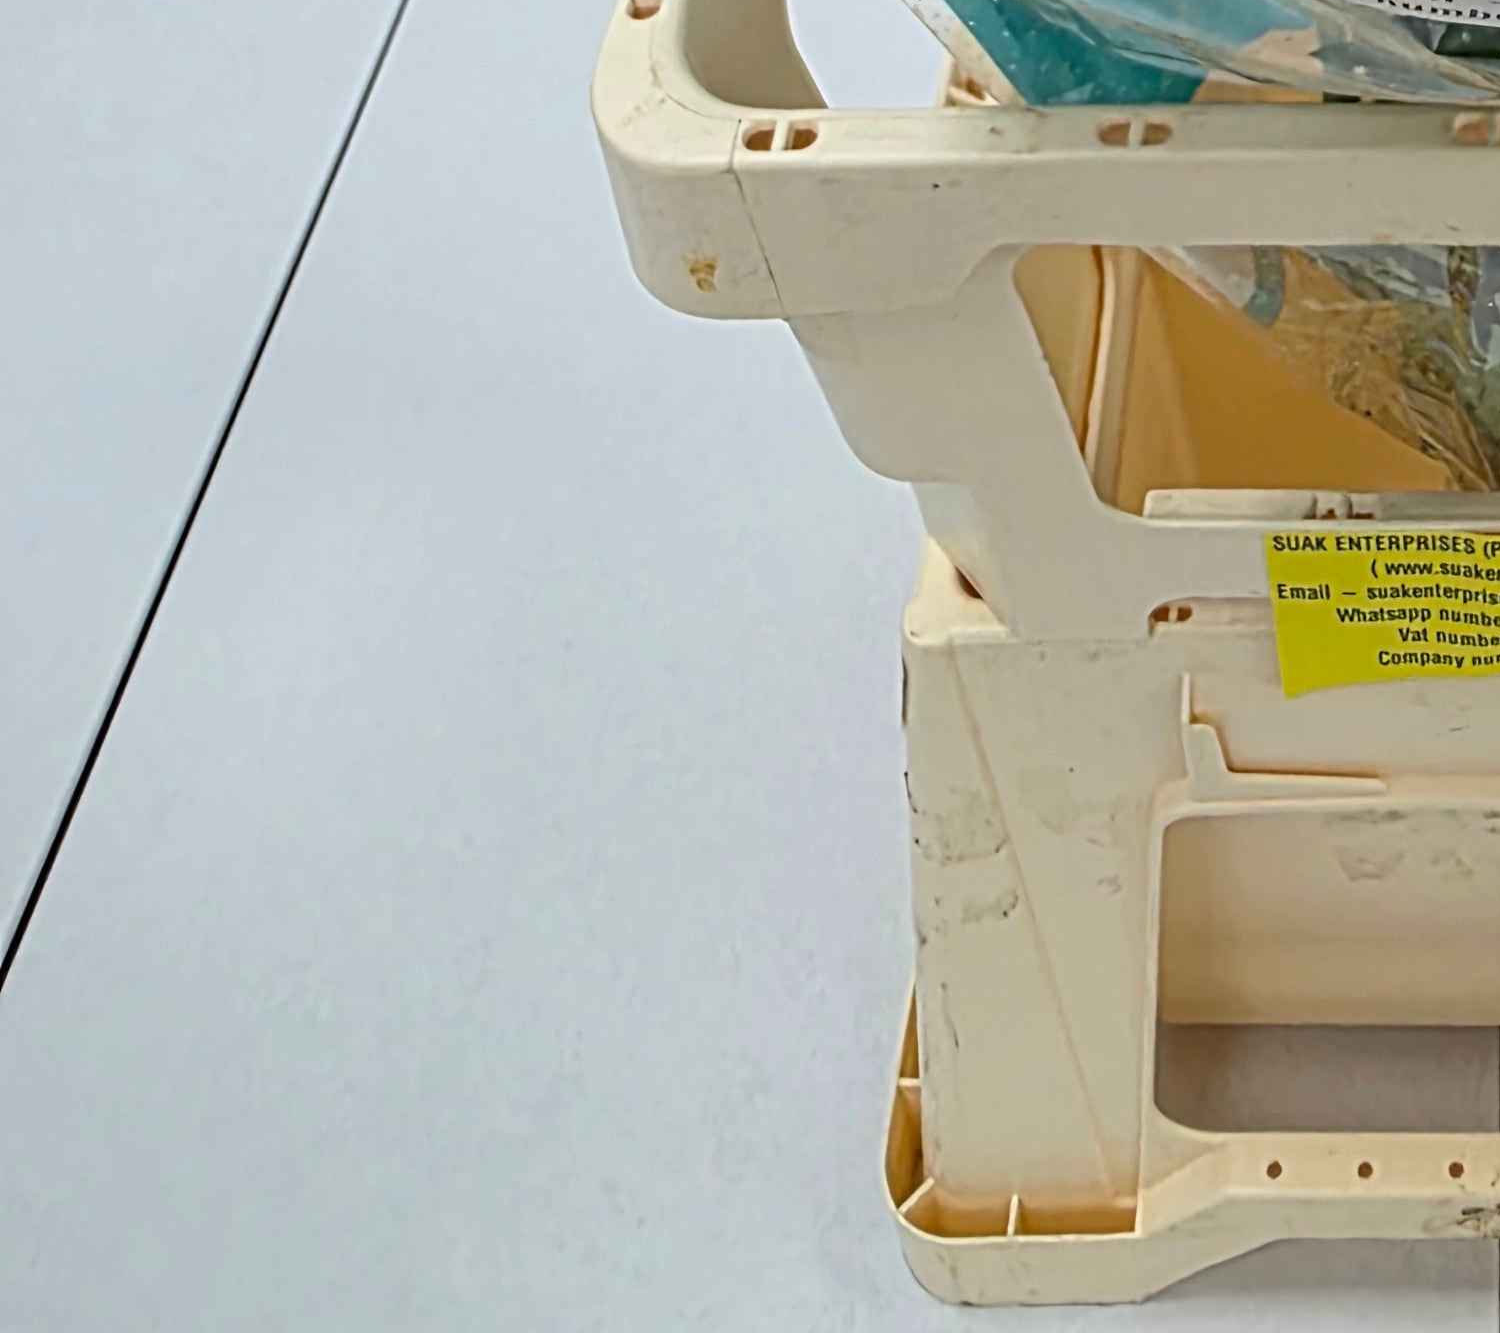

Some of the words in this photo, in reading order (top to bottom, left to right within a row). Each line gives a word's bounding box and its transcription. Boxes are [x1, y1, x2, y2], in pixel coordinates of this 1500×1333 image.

[1273, 535, 1328, 552] SUAK
[1335, 535, 1476, 554] ENTERPRISES
[1277, 583, 1331, 600] Email
[1336, 607, 1432, 623] Whatsapp
[1398, 627, 1429, 643] Vat
[1378, 650, 1465, 669] Company
